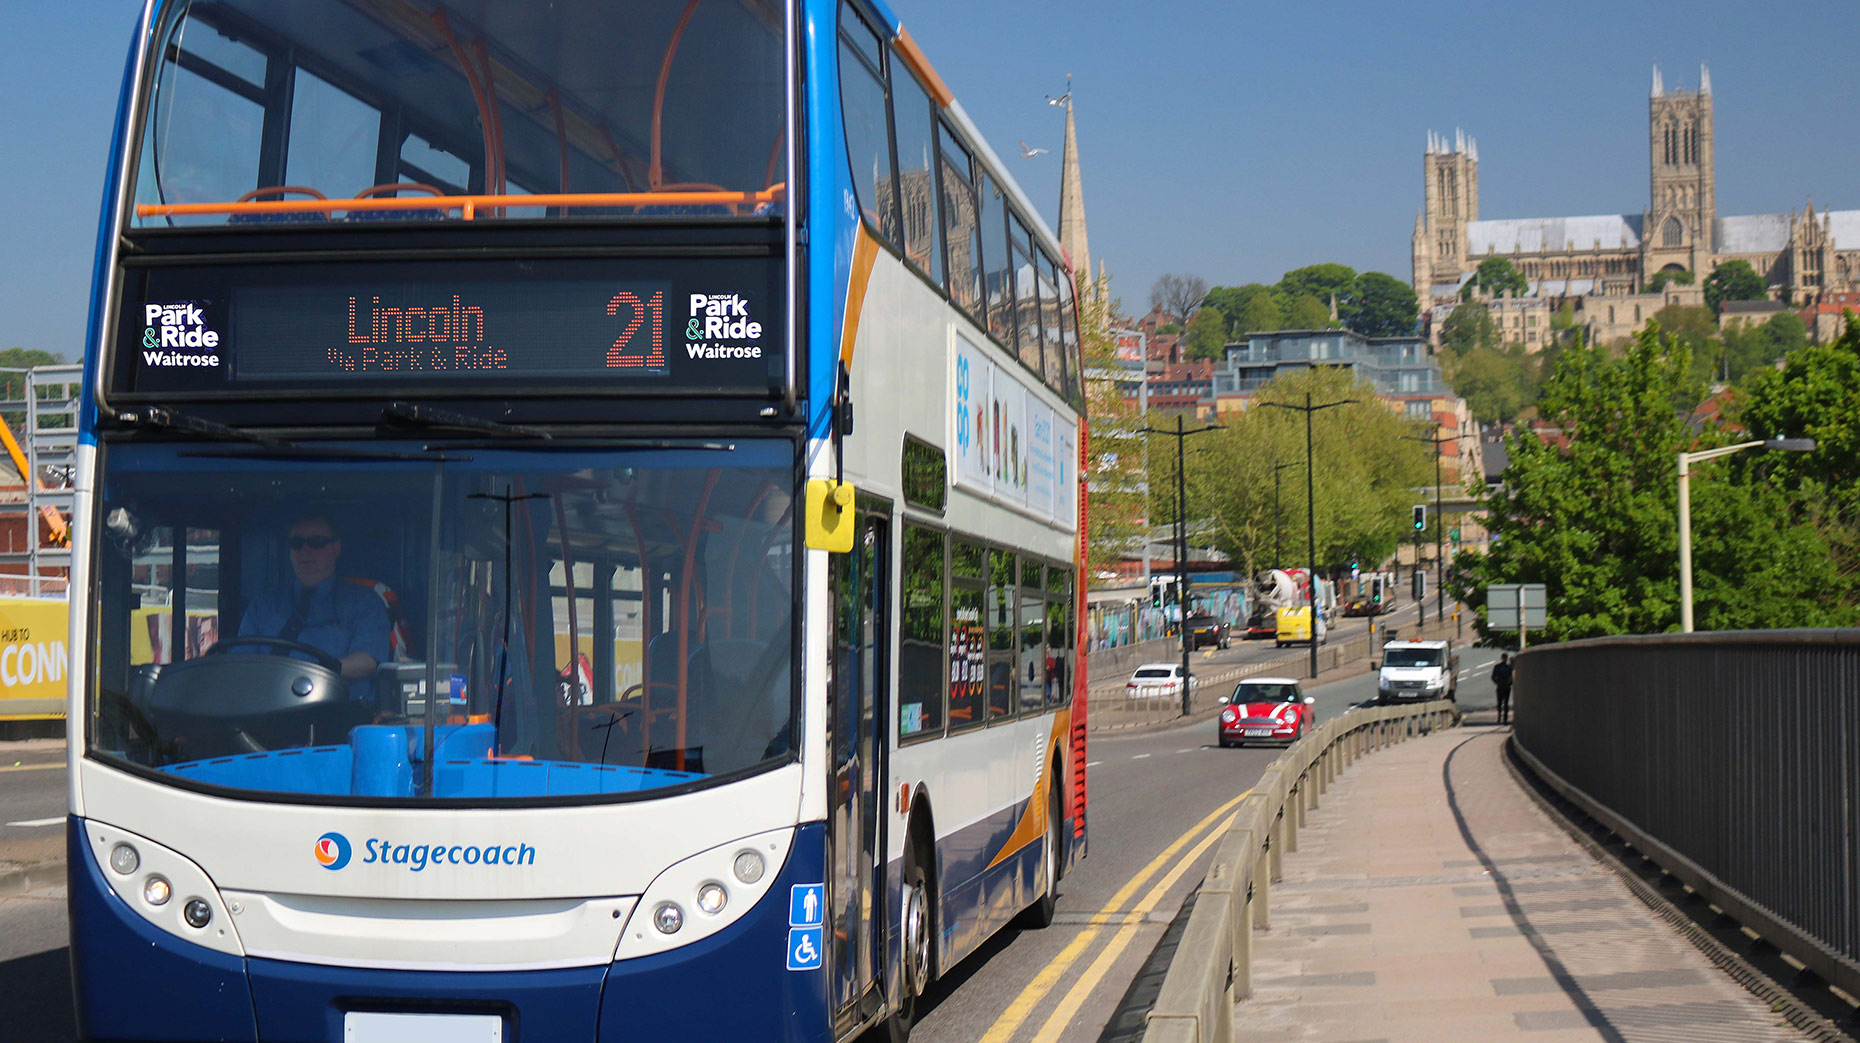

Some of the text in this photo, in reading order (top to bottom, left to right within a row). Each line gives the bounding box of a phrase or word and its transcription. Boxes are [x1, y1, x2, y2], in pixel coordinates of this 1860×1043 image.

[145, 303, 204, 326] Park
[690, 293, 748, 317] Park
[349, 294, 483, 343] Lincoln
[606, 291, 665, 368] 21
[685, 315, 762, 340] & Ride
[143, 325, 219, 348] & Ride
[143, 351, 219, 367] Waitrose
[363, 347, 424, 371] Park
[431, 346, 447, 370] &
[455, 345, 507, 370] Ride
[685, 343, 762, 359] Waitrose
[363, 837, 536, 872] Stagecoach
